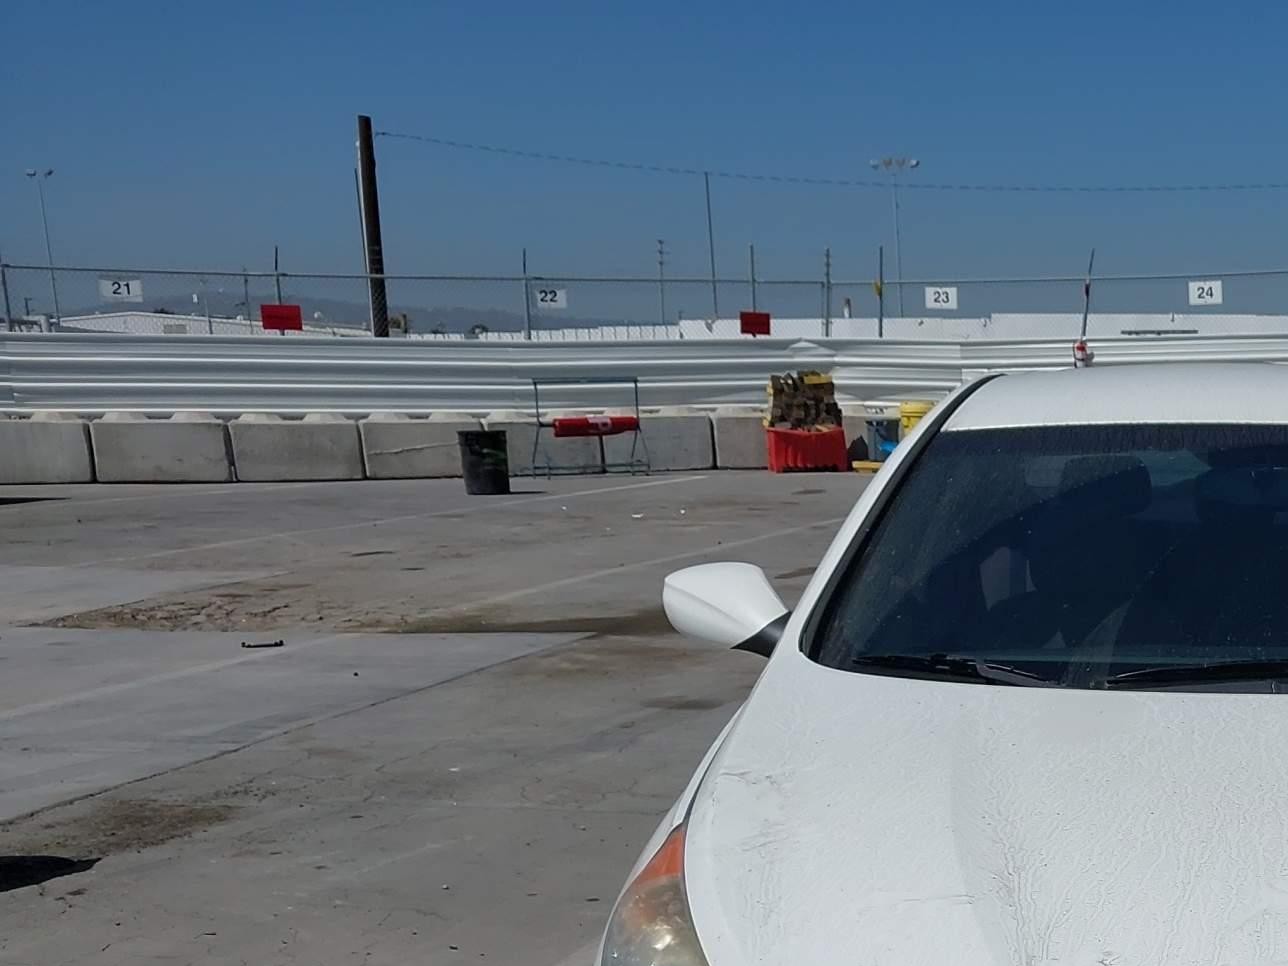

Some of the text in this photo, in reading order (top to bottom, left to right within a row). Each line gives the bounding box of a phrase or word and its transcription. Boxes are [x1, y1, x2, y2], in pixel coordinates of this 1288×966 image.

[111, 281, 131, 295] 21
[1197, 286, 1214, 299] 24
[538, 289, 559, 303] 22
[933, 290, 950, 304] 23
